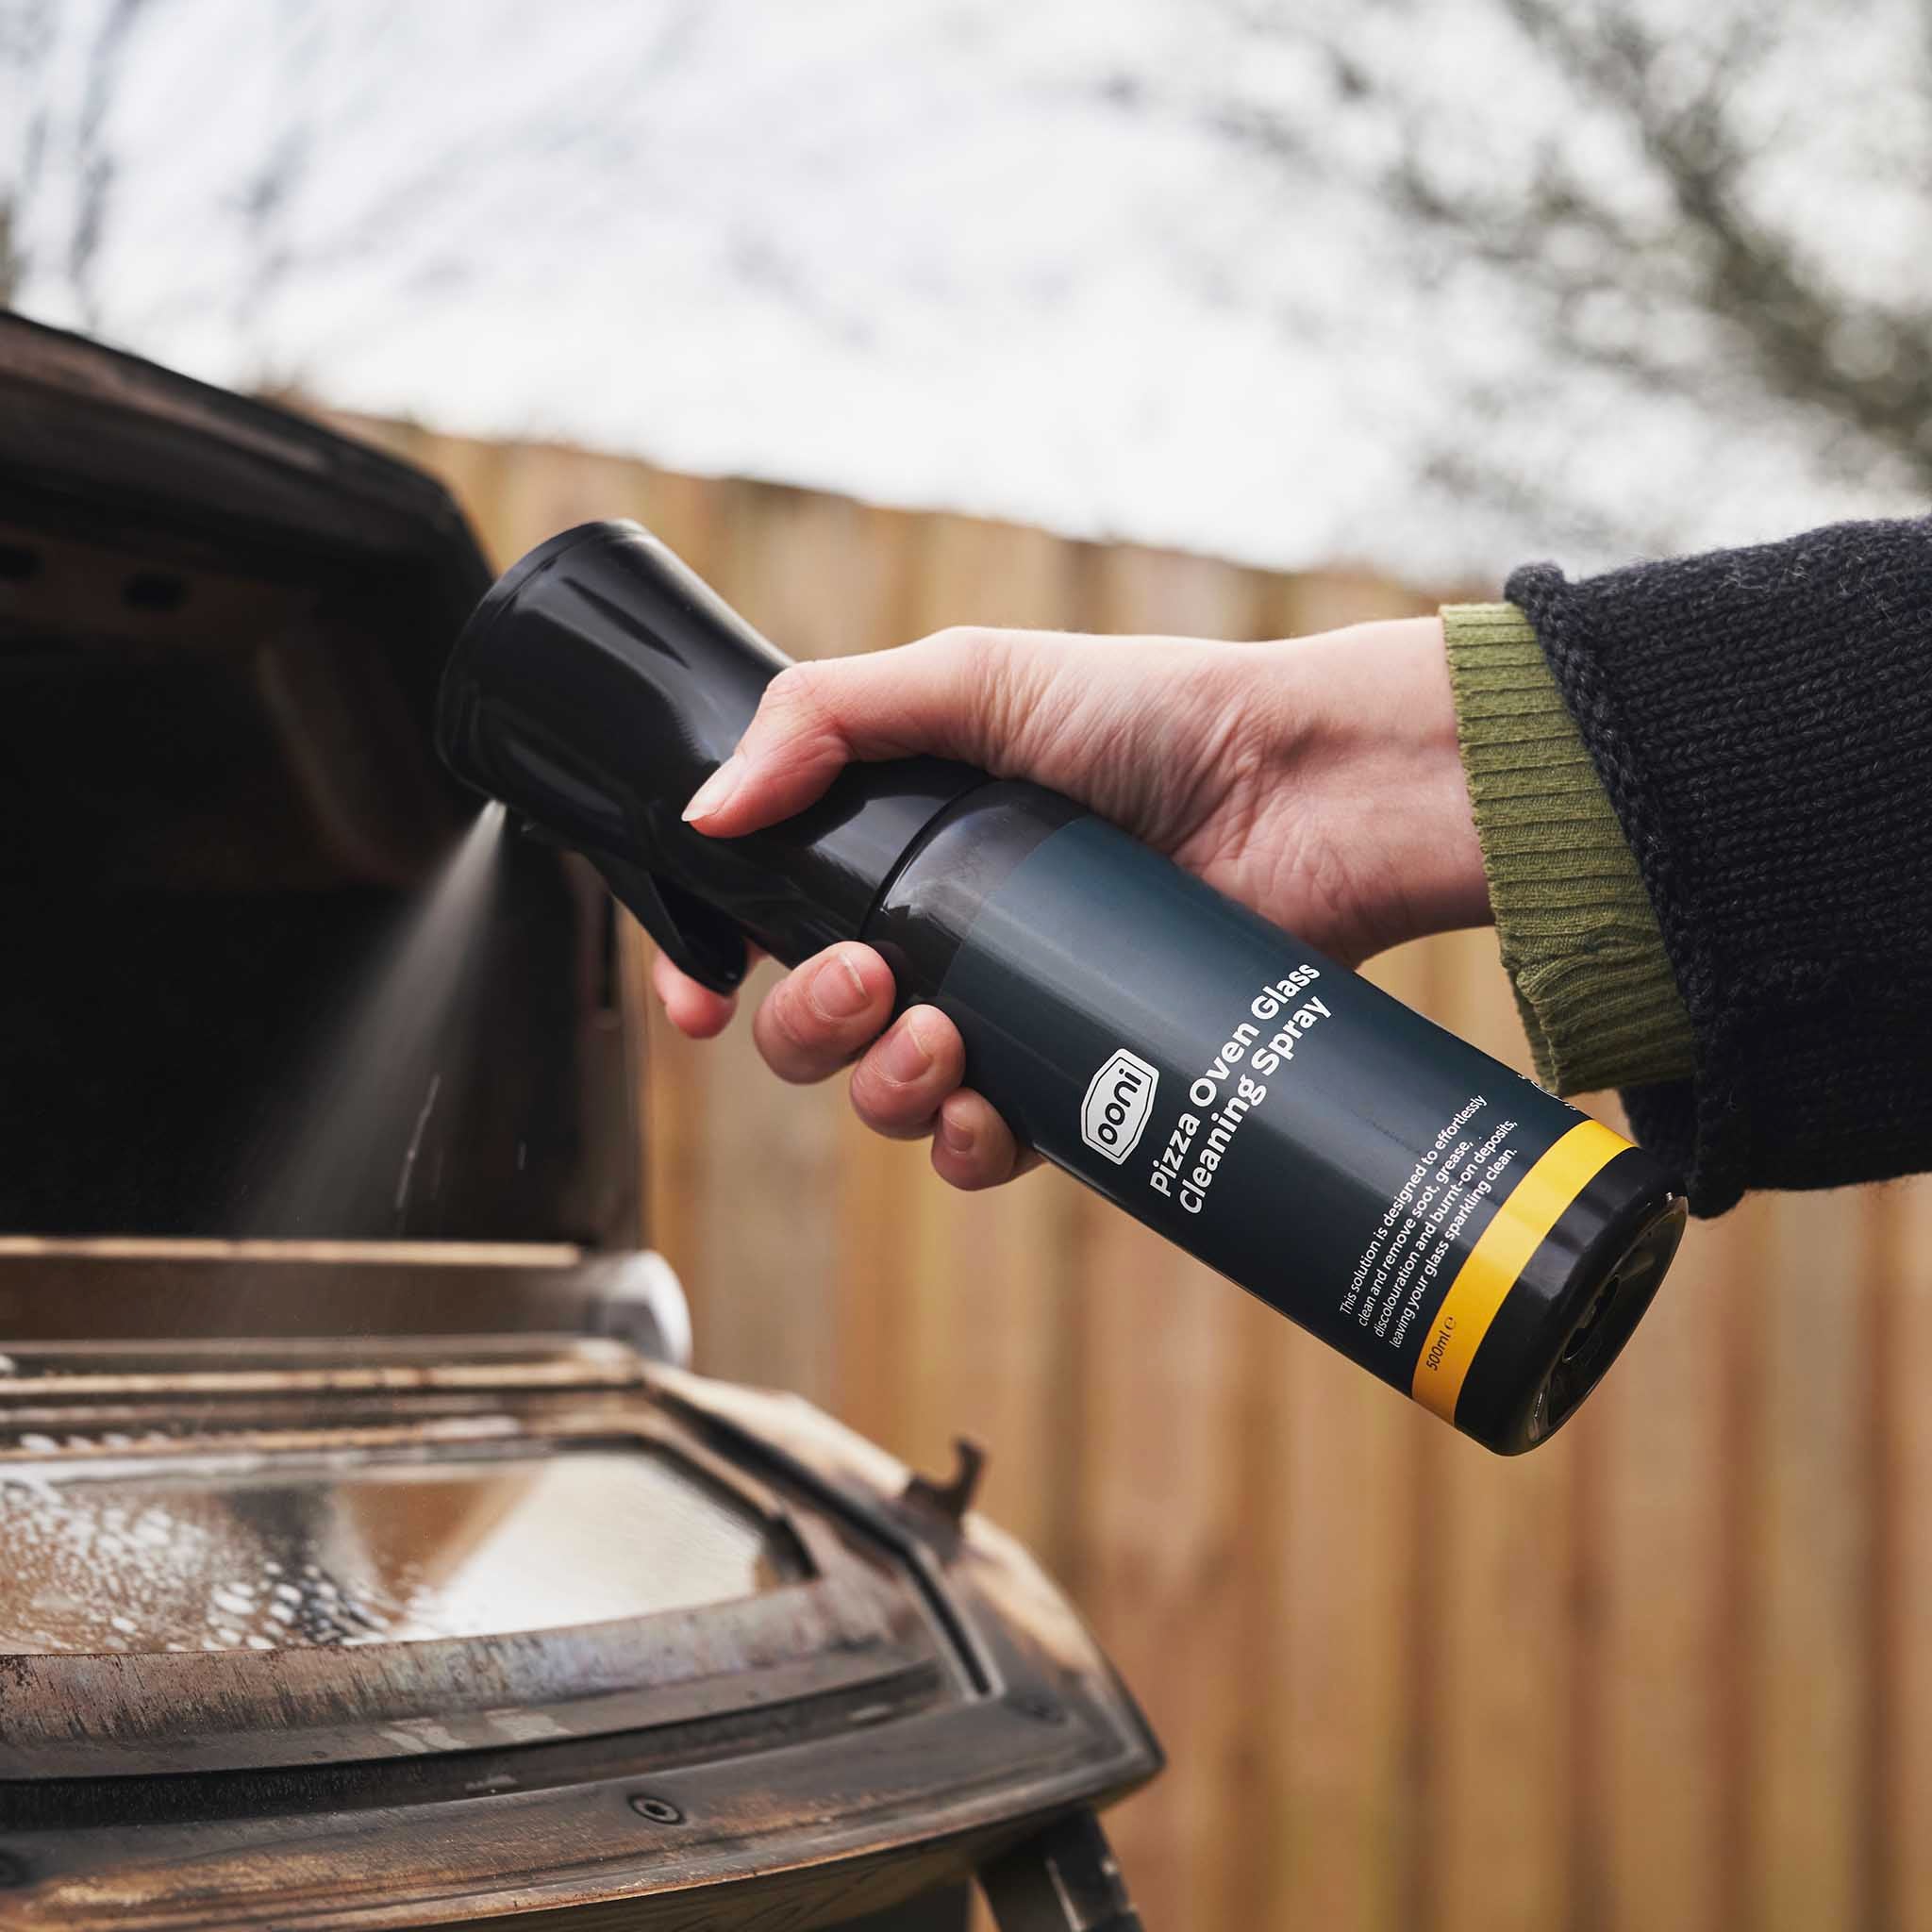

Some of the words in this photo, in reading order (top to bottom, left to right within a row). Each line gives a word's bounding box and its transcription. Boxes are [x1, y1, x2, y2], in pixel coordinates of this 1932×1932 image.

[1097, 1067, 1142, 1145] ooni
[1149, 1112, 1201, 1197] Pizza
[1189, 1022, 1260, 1108] Oven
[1251, 964, 1321, 1020] Glass
[1179, 1074, 1267, 1214] Cleaning
[1251, 995, 1332, 1076] Spray
[1340, 1291, 1357, 1315] This
[1351, 1240, 1381, 1292] solution
[1373, 1226, 1388, 1241] is
[1383, 1164, 1427, 1227] designed
[1421, 1150, 1438, 1165] to
[1435, 1094, 1488, 1150] effortlessly
[1358, 1295, 1375, 1326] clean
[1370, 1269, 1388, 1296] and
[1382, 1218, 1416, 1271] remove
[1411, 1185, 1441, 1218] soot,
[1435, 1141, 1474, 1184] grease,
[1373, 1251, 1420, 1338] discolouration
[1415, 1221, 1438, 1252] and
[1429, 1163, 1478, 1224] burnt-on
[1474, 1120, 1518, 1164] deposits,
[1389, 1308, 1415, 1348] leaving
[1407, 1274, 1429, 1310] your
[1424, 1240, 1449, 1277] glass
[1444, 1180, 1492, 1241] sparkling
[1486, 1149, 1518, 1181] clean.
[1426, 1329, 1451, 1371] 500ml
